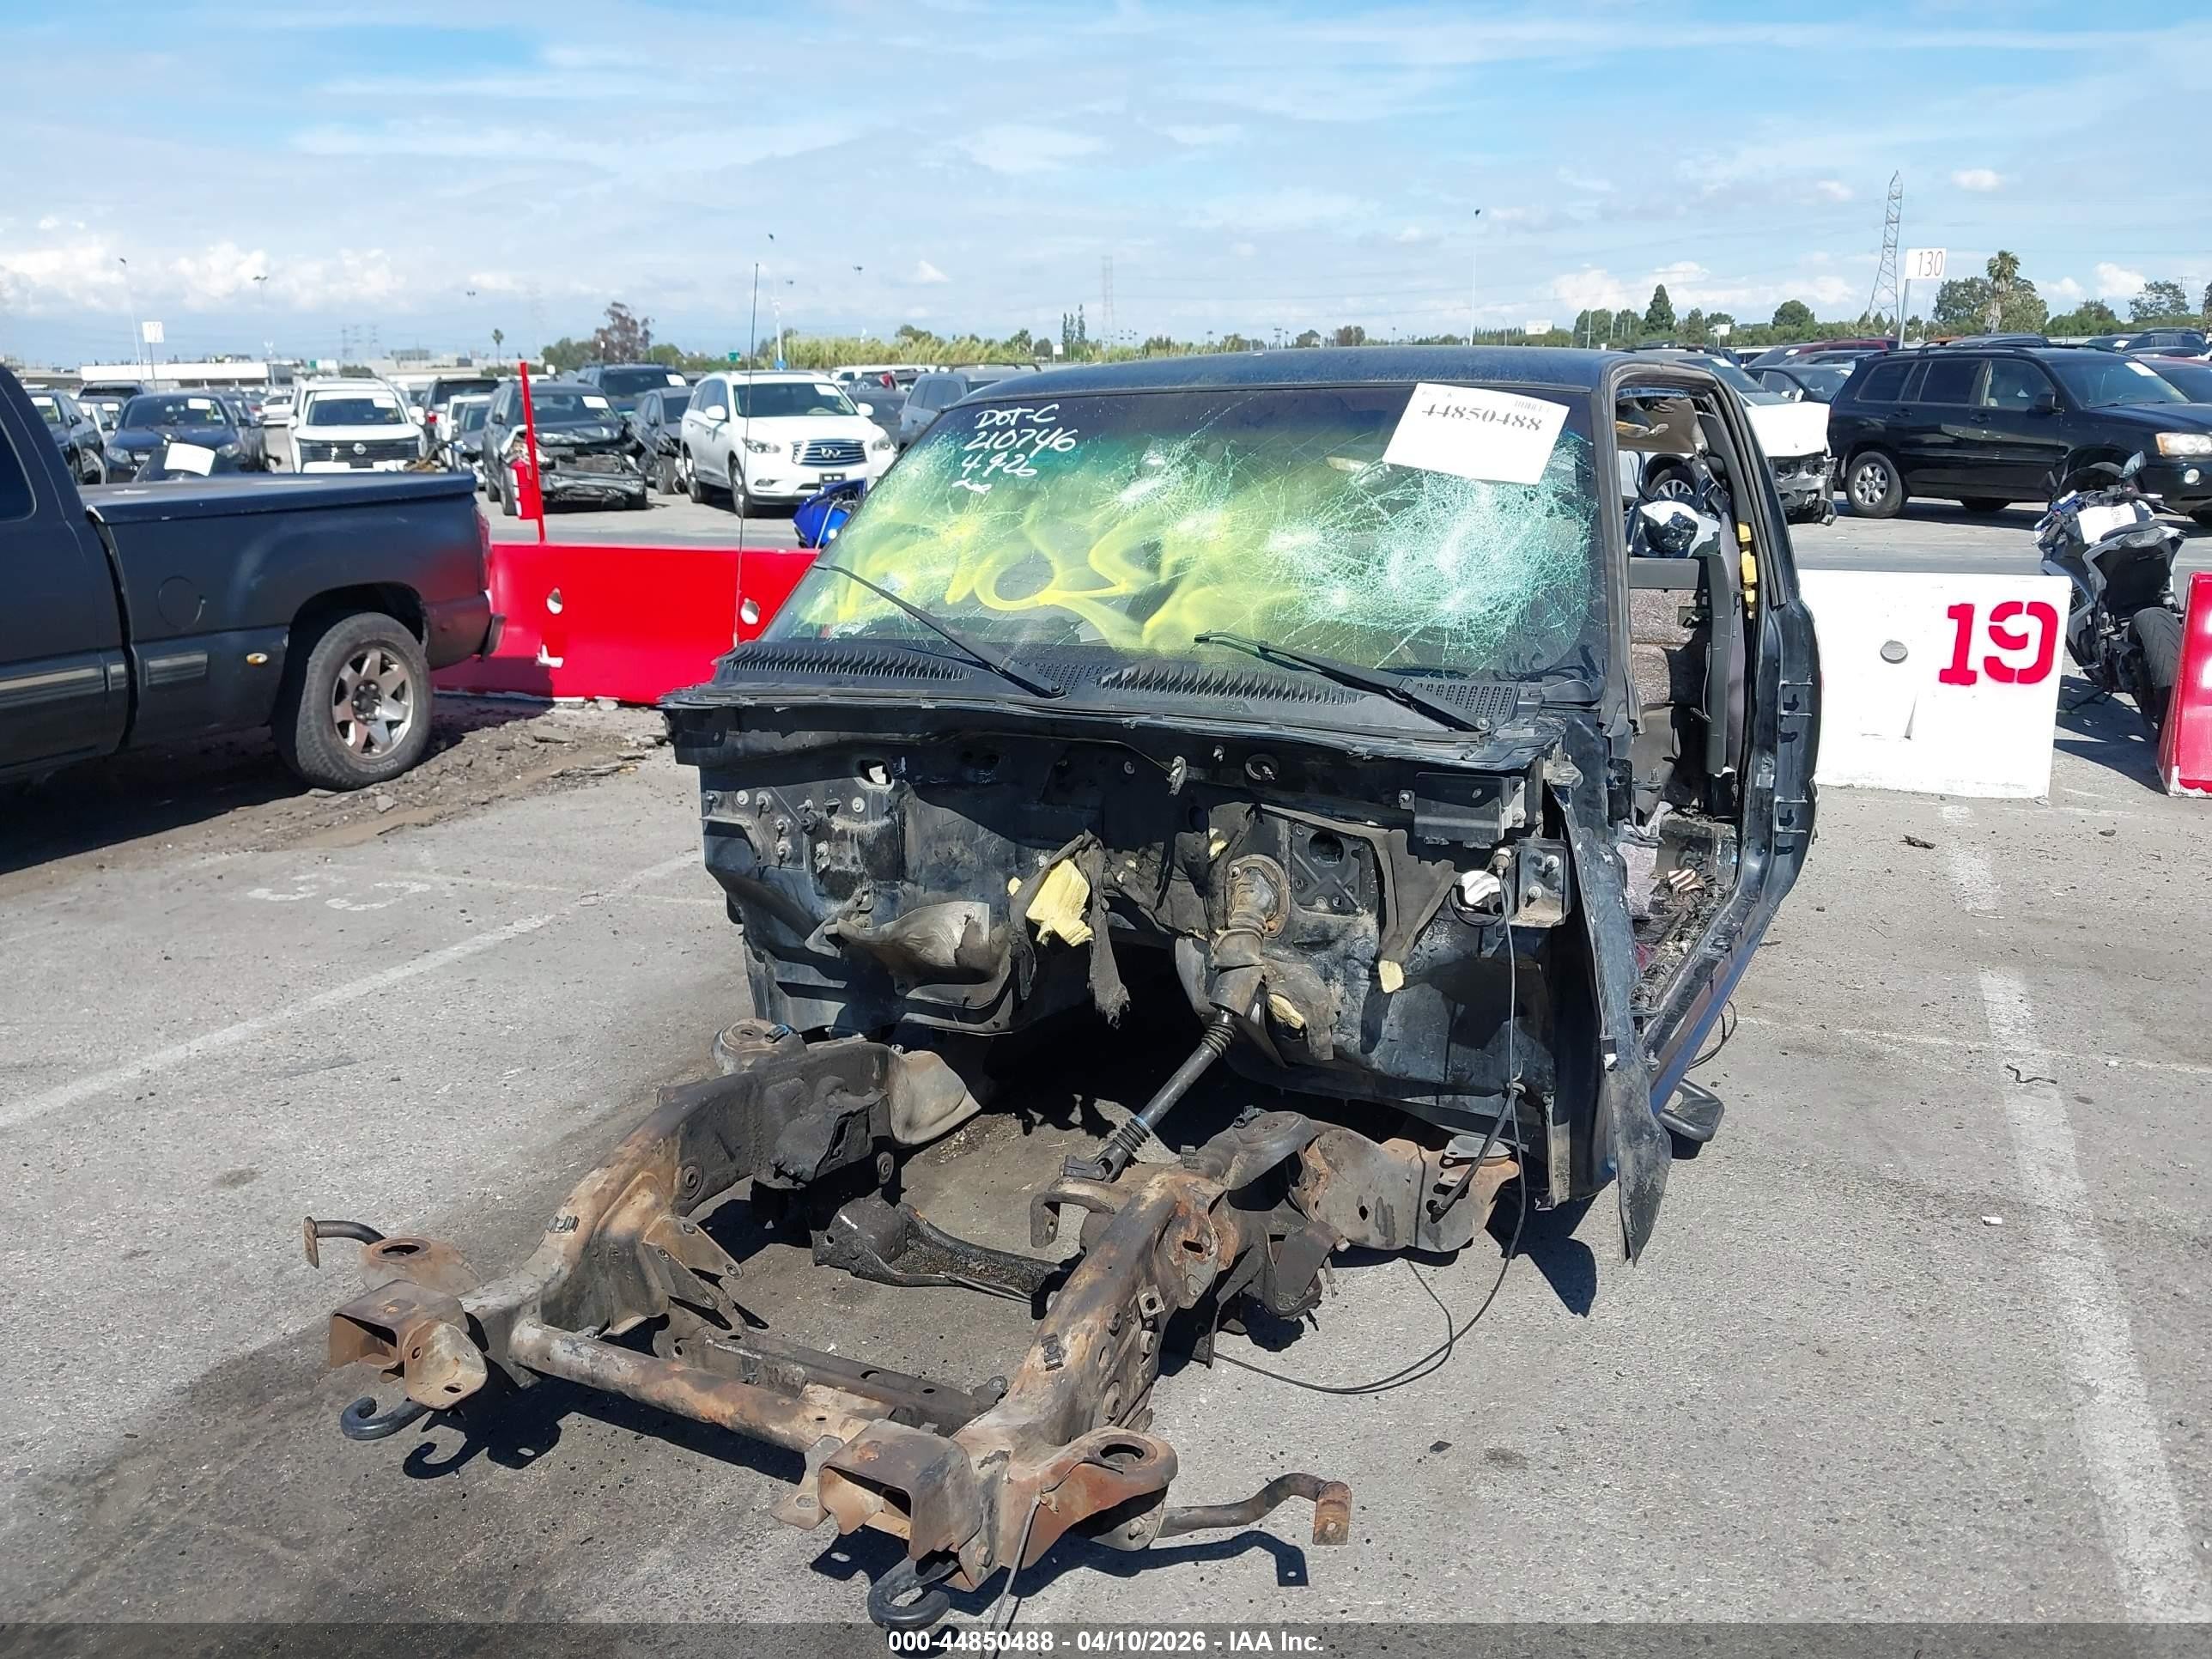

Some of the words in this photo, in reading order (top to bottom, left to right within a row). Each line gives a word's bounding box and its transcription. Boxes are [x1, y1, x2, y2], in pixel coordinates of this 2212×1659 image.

[1917, 250, 1943, 276] 130
[974, 404, 1060, 429] DOT-C
[1422, 404, 1543, 431] 44850488
[963, 427, 1079, 458] 210746
[1939, 600, 2059, 686] 19
